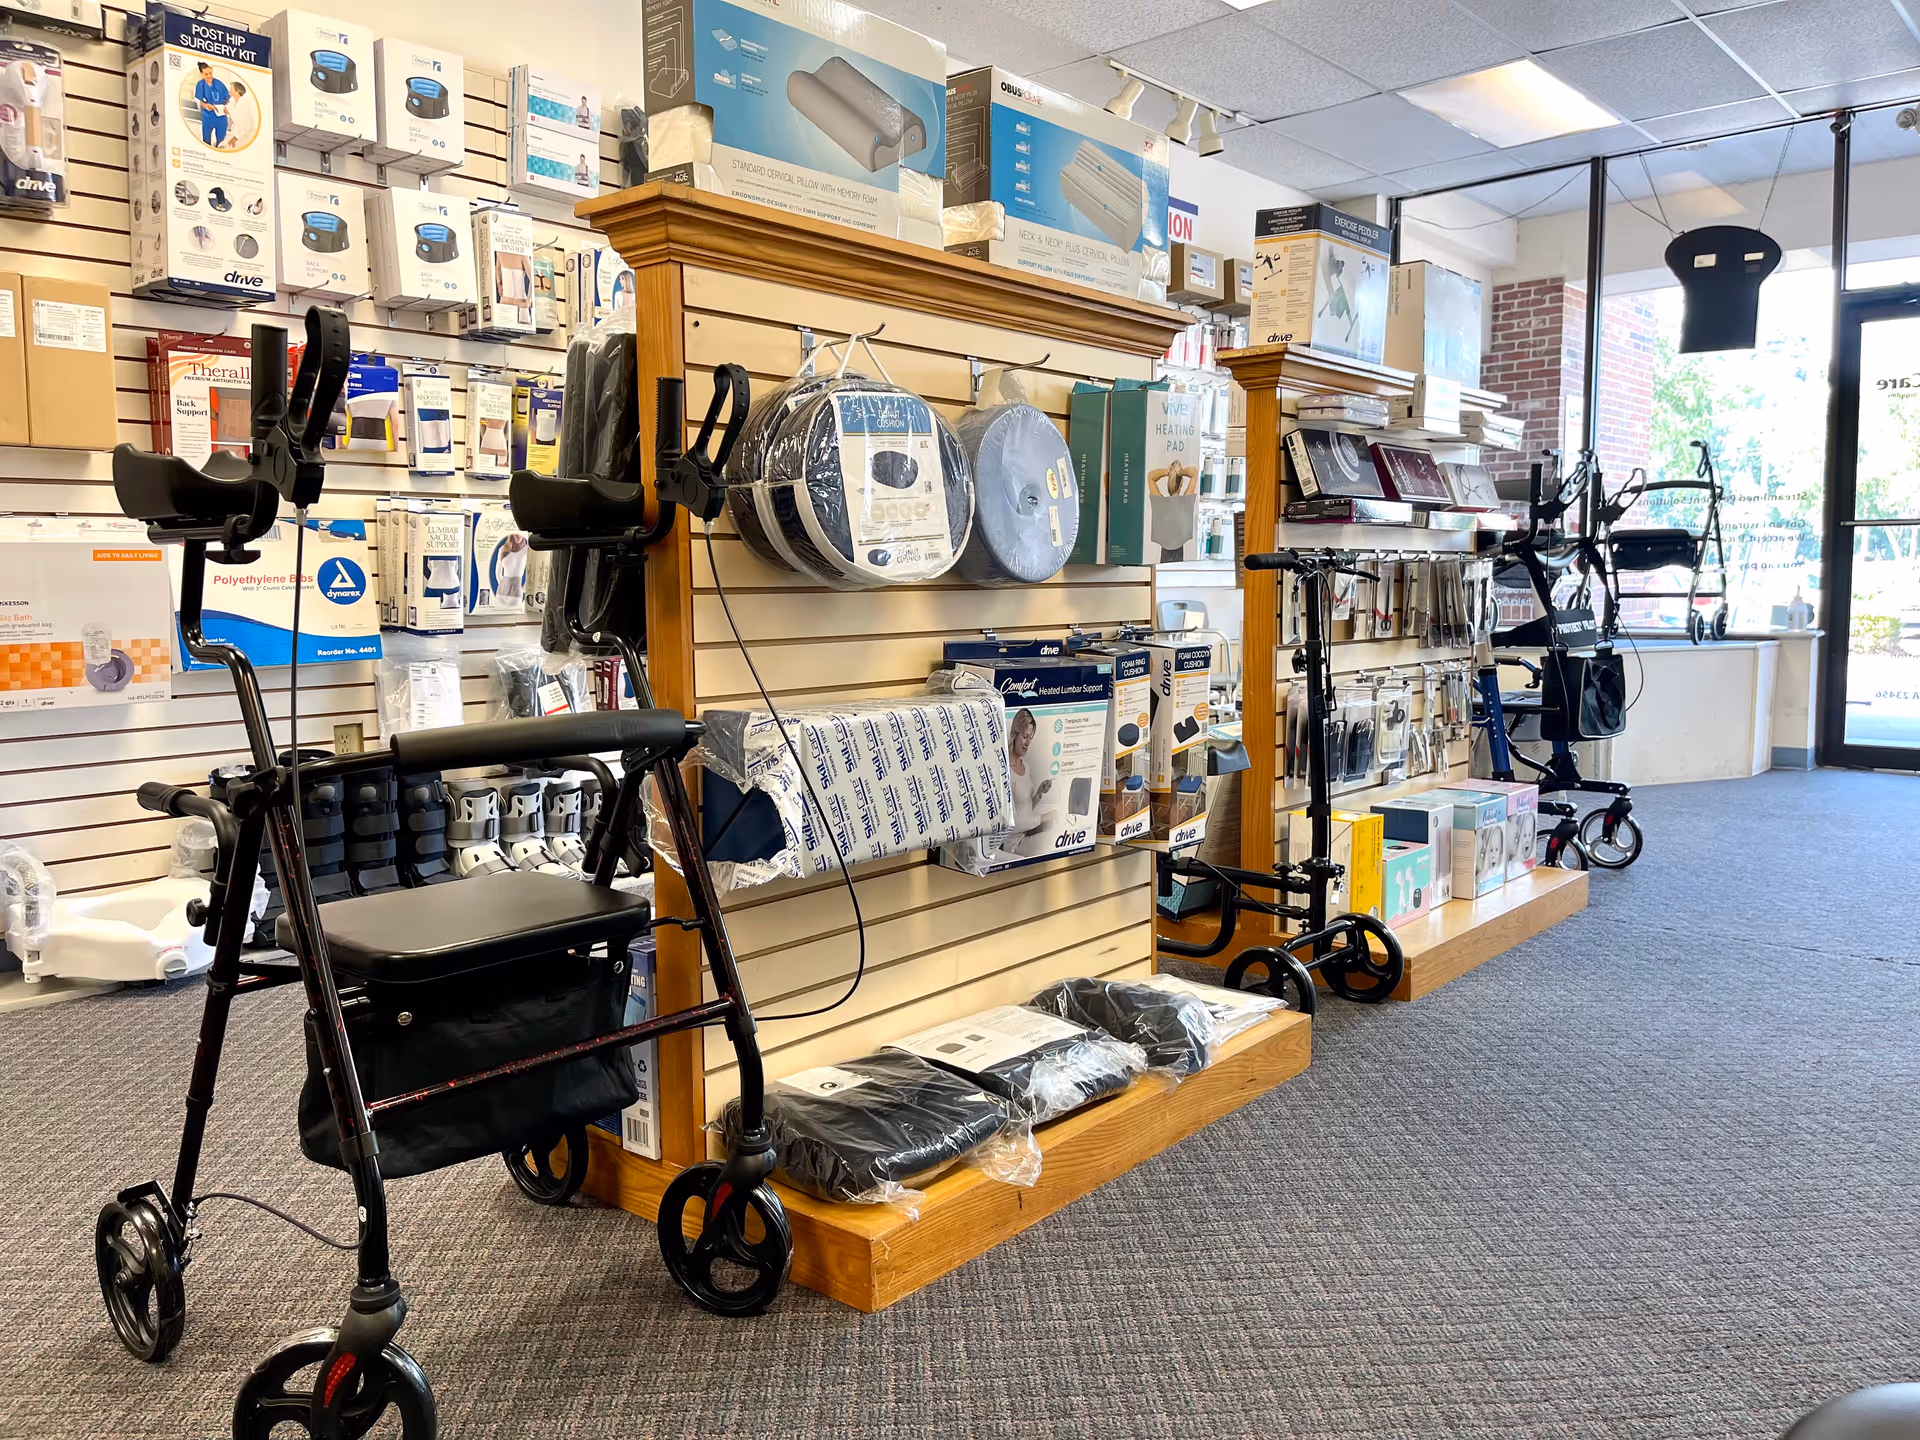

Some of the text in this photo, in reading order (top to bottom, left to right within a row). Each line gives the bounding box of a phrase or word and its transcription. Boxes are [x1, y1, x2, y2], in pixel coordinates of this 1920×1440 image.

[192, 24, 246, 46] POST HIP
[180, 34, 257, 63] SURGERY KIT
[16, 177, 57, 193] drive
[732, 159, 766, 176] STANDARD
[767, 168, 795, 184] CERVICAL
[796, 176, 820, 190] PILLOW
[820, 182, 836, 193] WITH
[837, 187, 861, 201] MEMORY
[862, 194, 878, 206] FOAM
[731, 190, 766, 204] ERGONOMIC
[767, 198, 788, 209] DESIGN
[788, 203, 802, 212] WITH
[802, 207, 817, 216] FIRM
[817, 211, 841, 222] SUPPORT
[842, 217, 852, 225] AND
[852, 220, 877, 231] COMFORT
[1168, 211, 1193, 242] ION
[1334, 215, 1379, 240] EXERCISE PEDDLER
[1019, 229, 1035, 241] NECK
[1037, 234, 1043, 244] &
[1065, 241, 1081, 255] PLUS
[1082, 246, 1109, 262] CERVICAL
[1110, 255, 1131, 267] PILLOW
[1018, 258, 1037, 269] SUPPORT
[1037, 263, 1053, 272] PILLOW
[1063, 270, 1074, 279] FOUR
[1074, 272, 1096, 283] DIFFERENT
[224, 271, 264, 288] drive
[163, 333, 184, 341] Therall
[1267, 332, 1293, 343] drive
[188, 362, 251, 380] Therall
[184, 375, 211, 383] PREMIUM
[176, 399, 197, 408] Back
[176, 407, 208, 417] Support
[878, 410, 900, 419] DONUT
[876, 419, 905, 428] CUSHION
[1155, 423, 1195, 437] HEATING
[1166, 440, 1185, 452] PAD
[428, 526, 459, 534] LUMBAR
[426, 541, 459, 549] SUPPORT
[896, 555, 921, 564] CUSHION
[898, 548, 919, 557] DONUT
[213, 573, 314, 587] Polyethylene Bbs
[327, 589, 361, 599] dynarex
[13, 613, 33, 621] Bath
[1556, 621, 1582, 635] PROTEKT
[317, 646, 377, 656] Reorder No. 4401
[1040, 645, 1060, 656] drive
[1178, 651, 1192, 660] FOAM
[1121, 657, 1146, 669] FOAM RING
[1183, 660, 1205, 669] CUSHION
[1123, 666, 1144, 677] CUSHION
[1160, 659, 1172, 697] drive
[1000, 677, 1103, 696] Comfort Heated Lumbar Support
[819, 727, 828, 744] 10701
[873, 721, 883, 738] 10701
[829, 752, 838, 778] Yonkers,
[883, 747, 892, 770] Yonkers,
[939, 767, 947, 782] 10701
[864, 779, 872, 794] 10701
[871, 803, 881, 827] Yonkers,
[1120, 821, 1143, 838] drive
[1175, 828, 1197, 843] drive
[1054, 829, 1087, 849] drive
